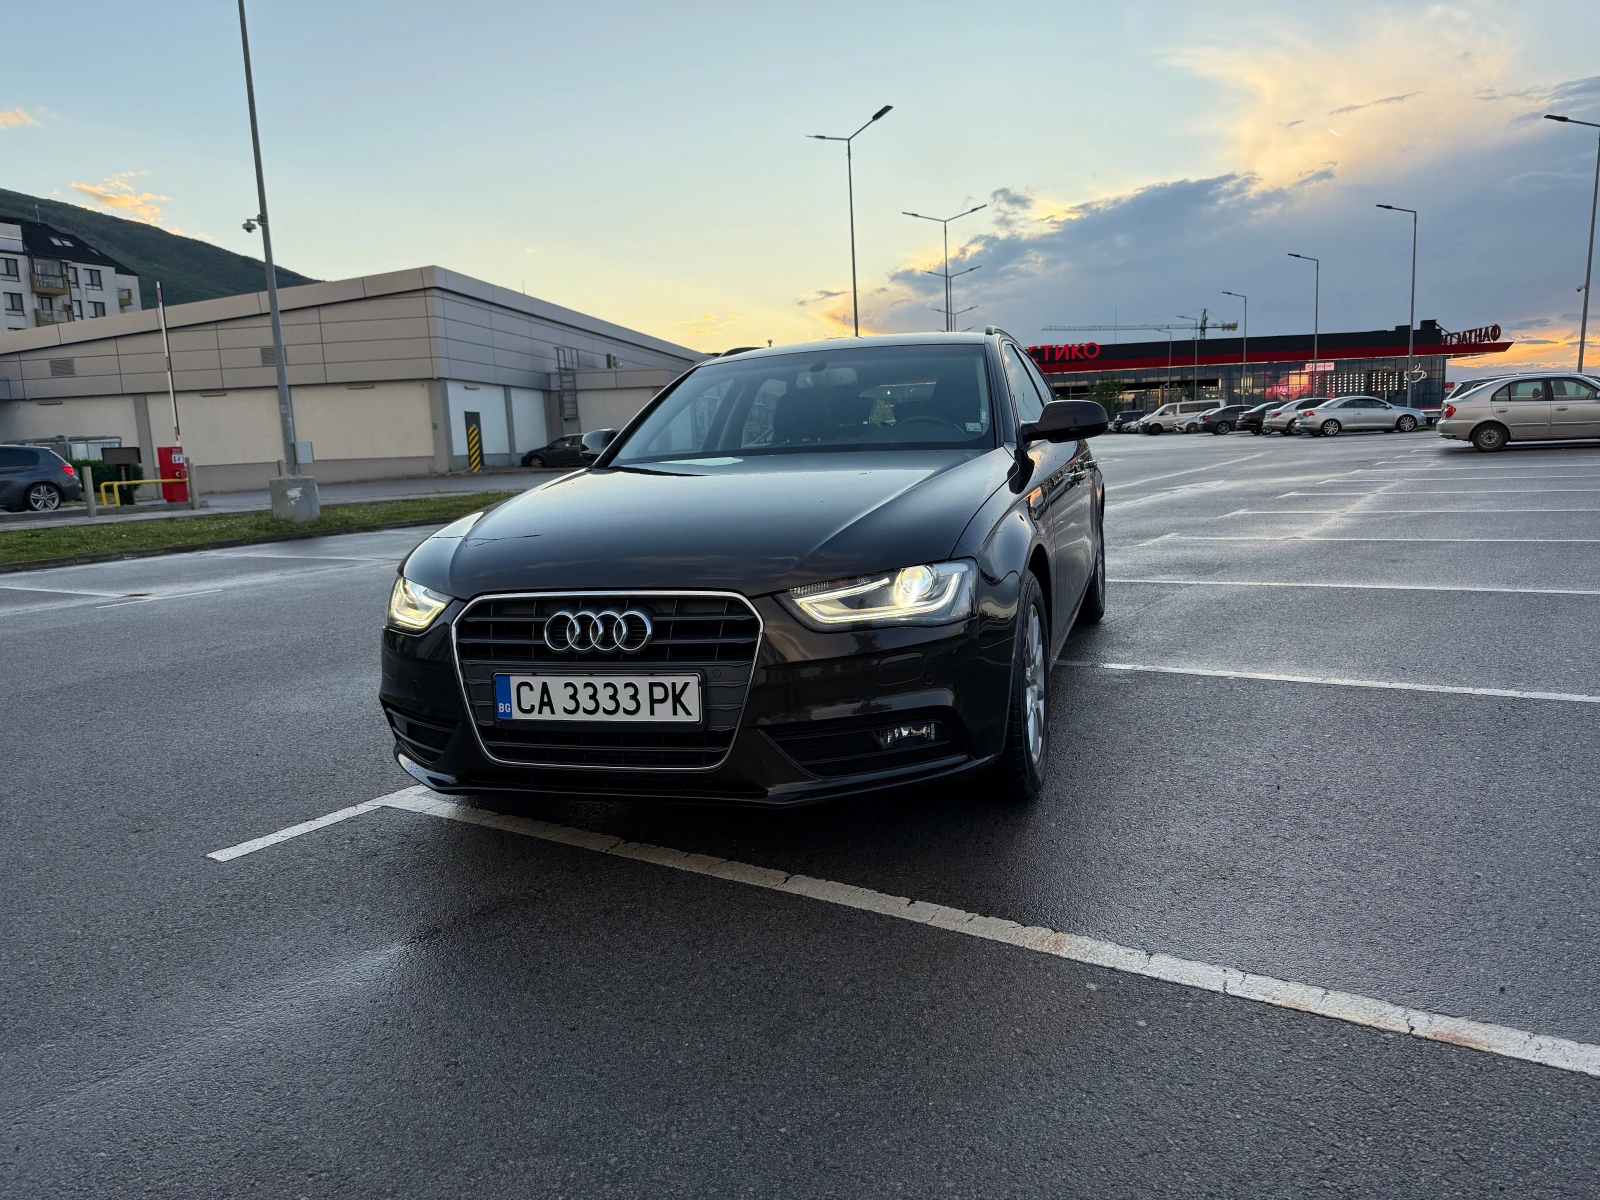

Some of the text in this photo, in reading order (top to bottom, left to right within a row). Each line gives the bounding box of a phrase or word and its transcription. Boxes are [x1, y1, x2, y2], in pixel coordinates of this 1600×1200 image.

[498, 702, 511, 713] BG
[516, 681, 693, 716] CA 3333 PK
